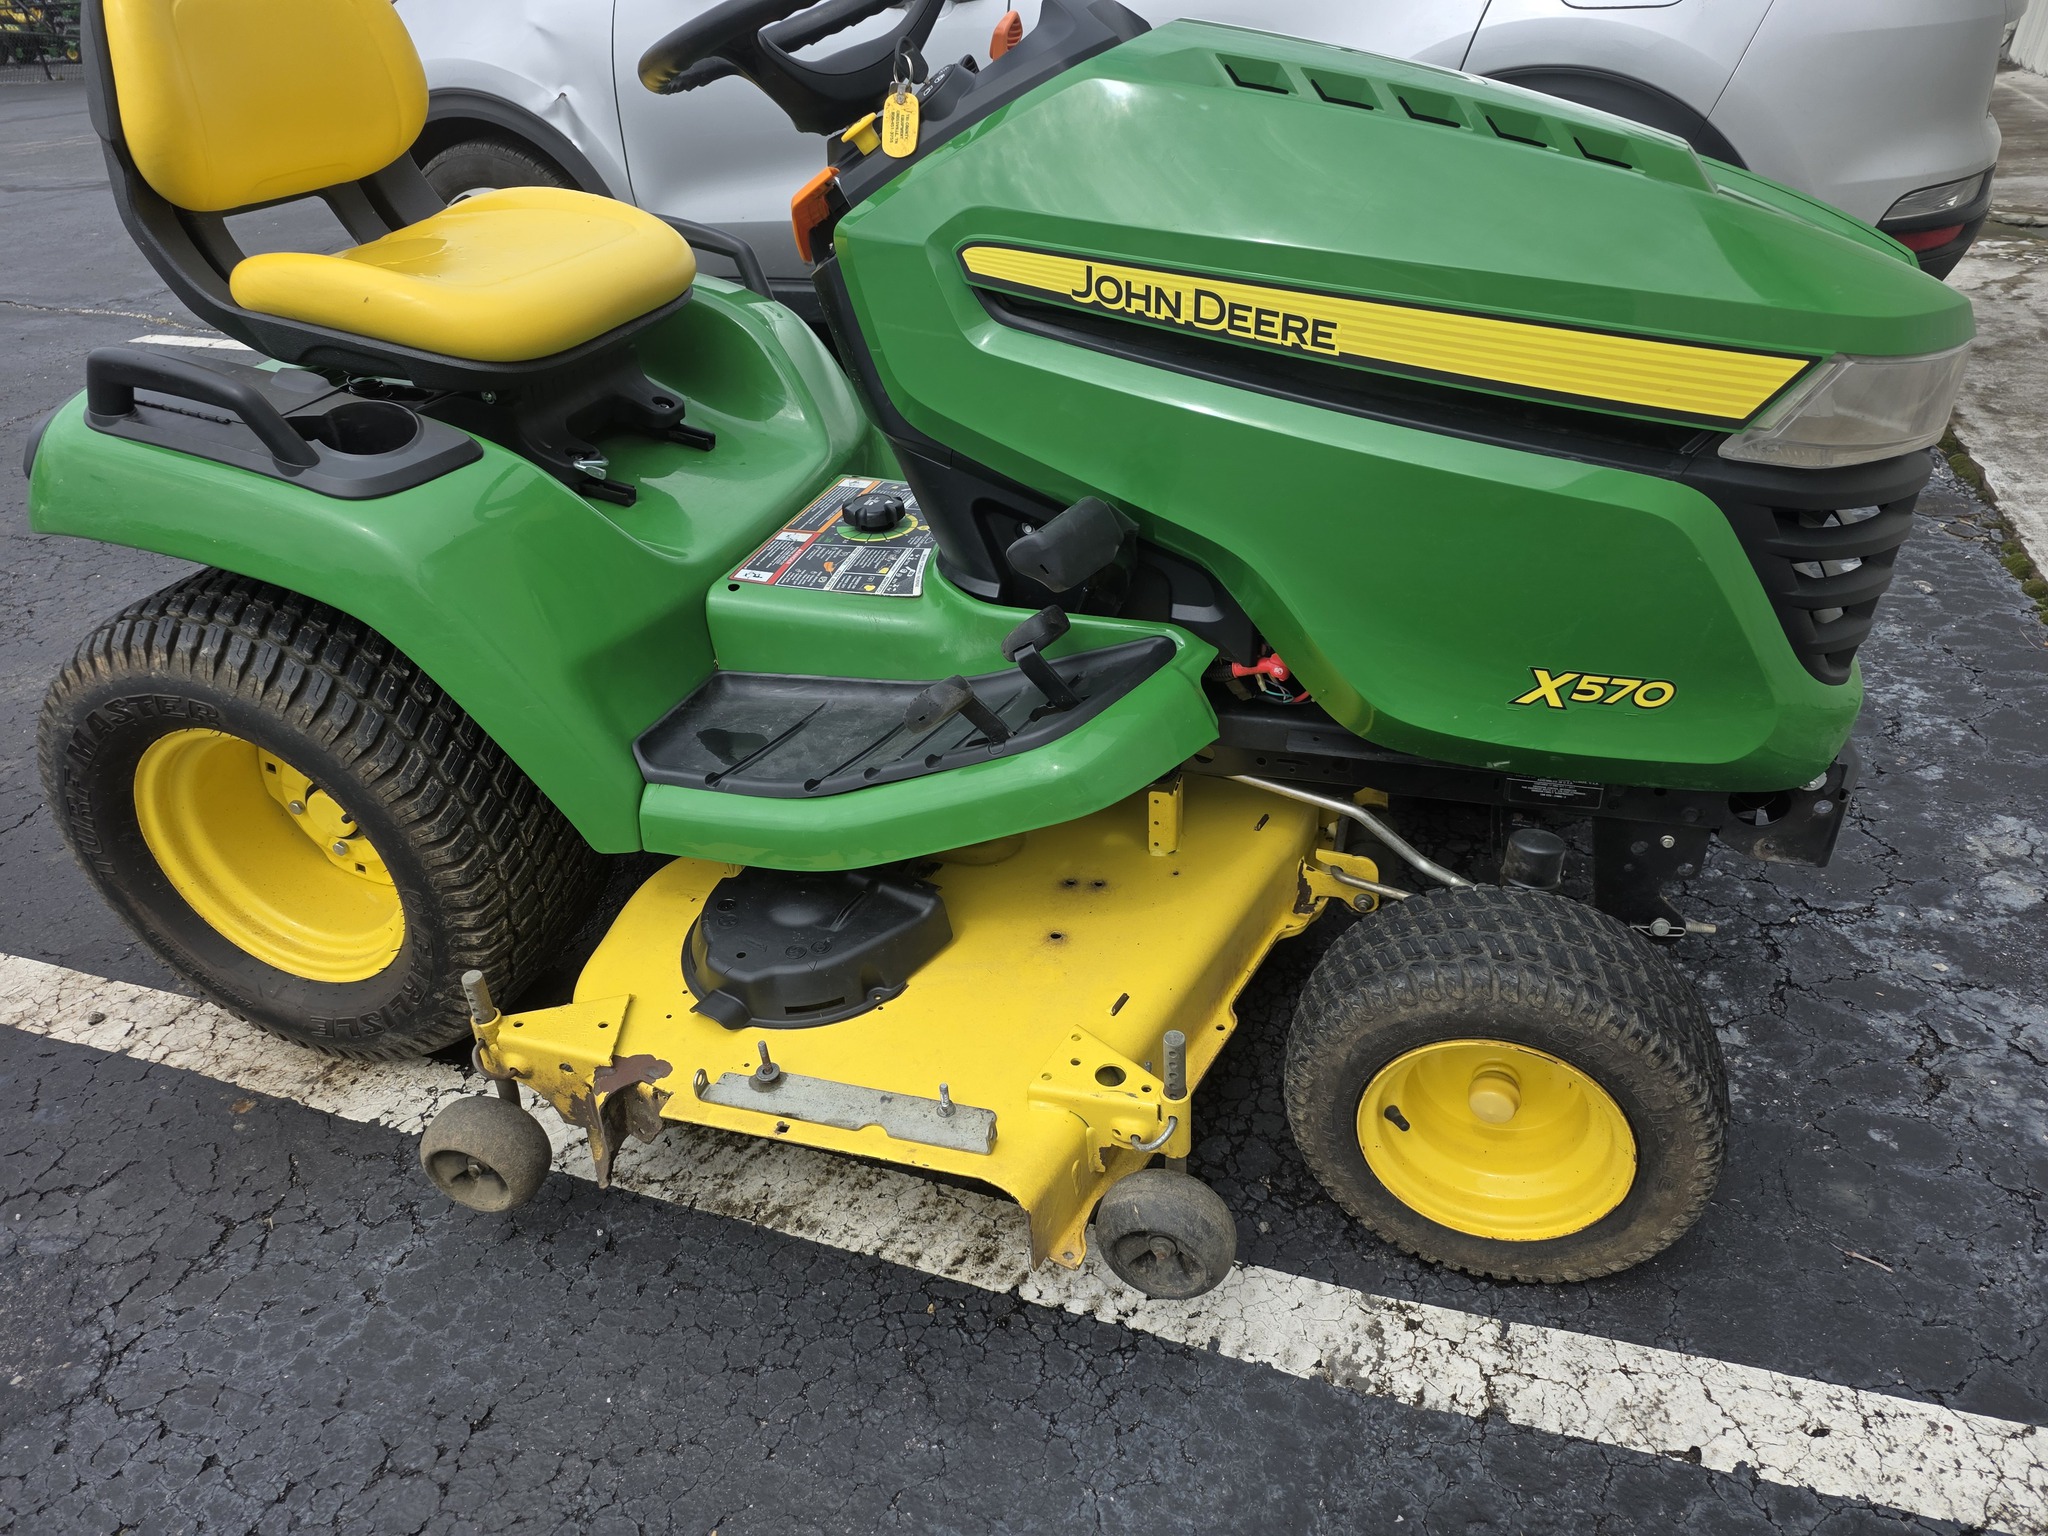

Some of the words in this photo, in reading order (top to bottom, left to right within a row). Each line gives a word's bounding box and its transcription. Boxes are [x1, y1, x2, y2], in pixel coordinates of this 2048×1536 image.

[1072, 265, 1182, 320] JOHN
[1193, 288, 1338, 351] DEERE
[65, 692, 221, 771] MASTER
[1508, 667, 1678, 710] X570
[63, 764, 117, 878] TURF
[309, 922, 434, 1039] CARLISLE
